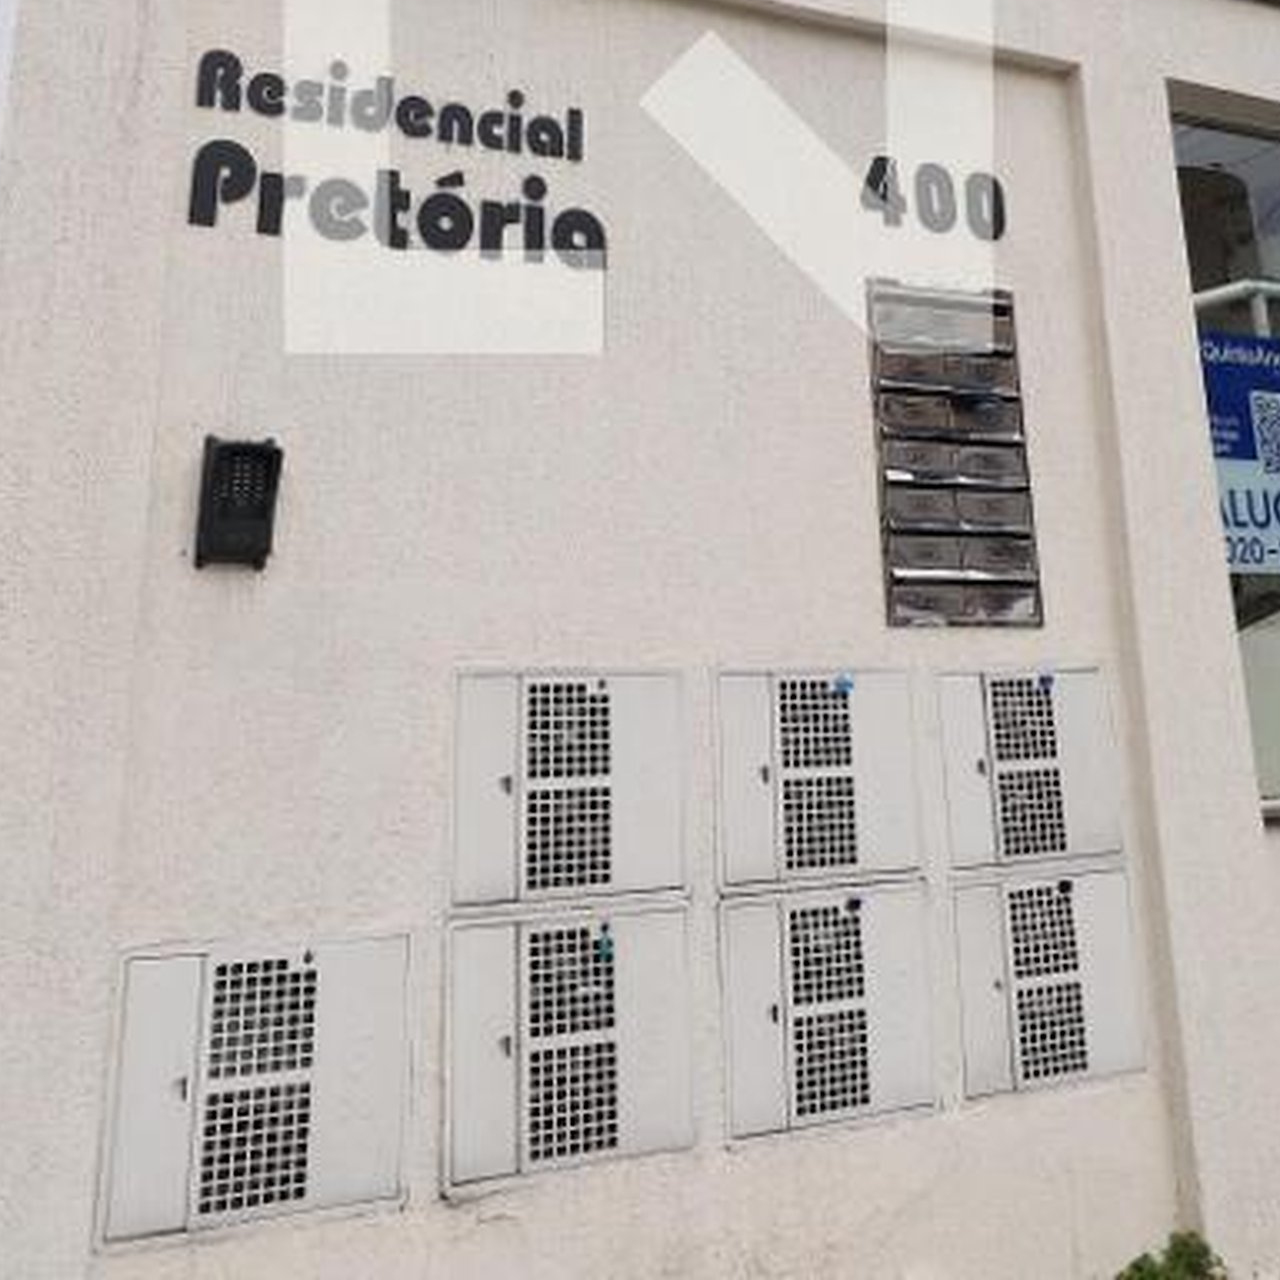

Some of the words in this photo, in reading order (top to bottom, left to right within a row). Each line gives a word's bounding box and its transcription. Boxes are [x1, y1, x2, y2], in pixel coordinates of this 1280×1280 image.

[196, 49, 584, 162] Residencial
[187, 139, 607, 270] Pretória
[860, 155, 1007, 241] 400
